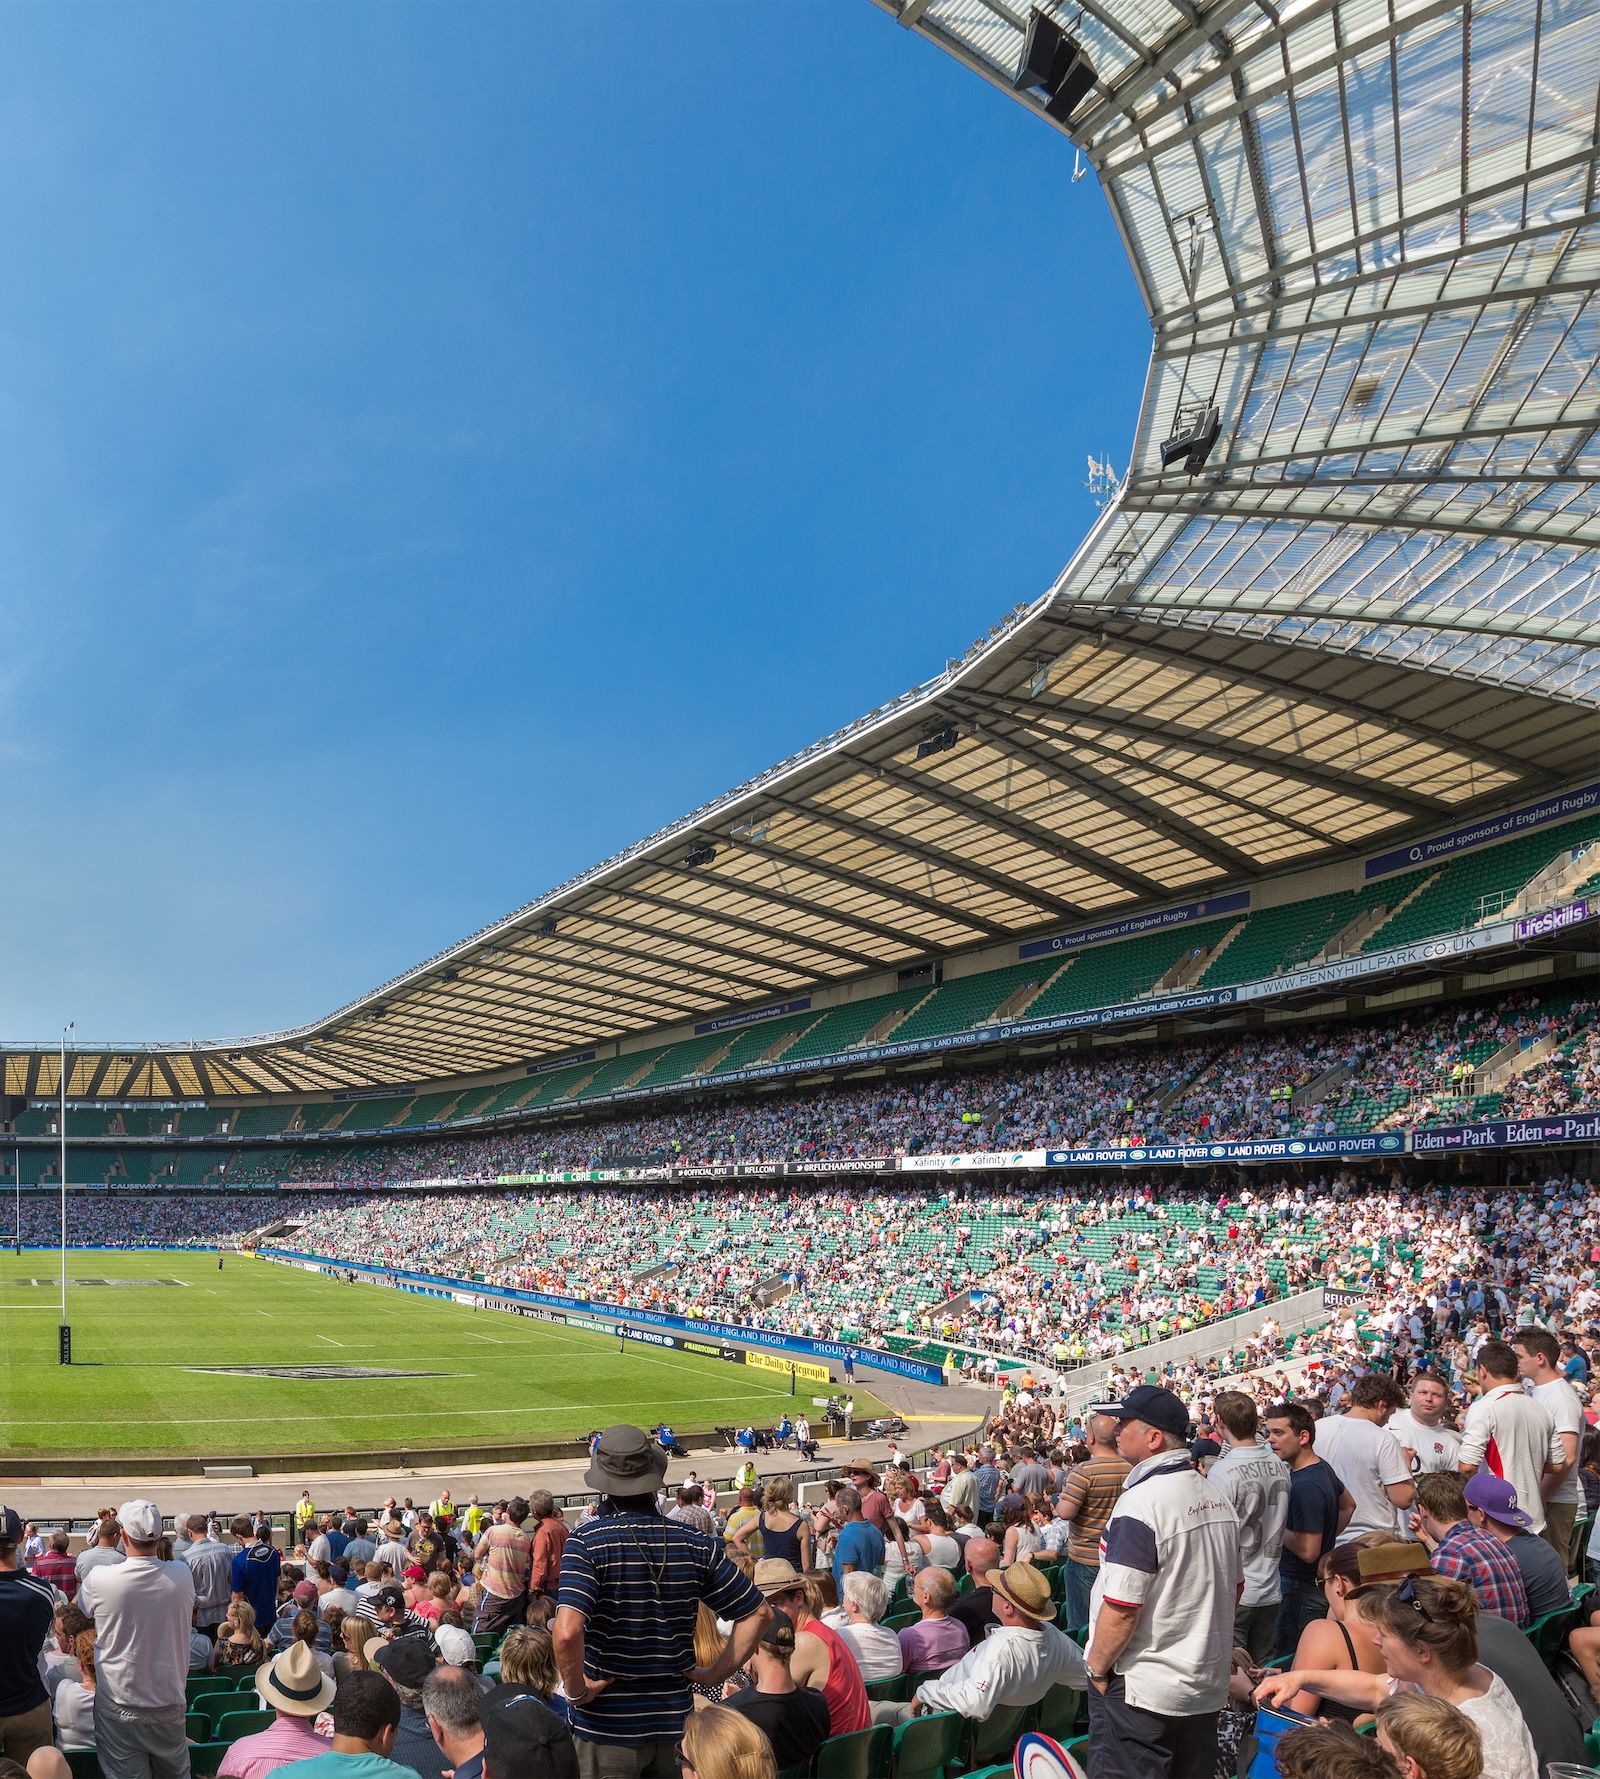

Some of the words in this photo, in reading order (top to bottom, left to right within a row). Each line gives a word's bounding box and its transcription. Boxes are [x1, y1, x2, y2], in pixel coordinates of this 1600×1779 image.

[1426, 839, 1455, 855] Proud
[1456, 824, 1500, 847] sponsors
[1502, 817, 1514, 830] of
[1516, 802, 1560, 827] England
[1561, 791, 1598, 812] Rugby
[1065, 934, 1086, 945] Proud
[1086, 927, 1119, 942] sponsors
[1120, 923, 1130, 932] of
[1130, 916, 1161, 931] England
[1163, 909, 1189, 922] Rugby
[1518, 905, 1583, 939] LifeSkills
[1264, 936, 1476, 994] WWW.PENNYHILLPARK.CO.UK
[1113, 995, 1215, 1019] RHINORUGBY.COM
[1011, 1014, 1098, 1034] RHINORUGBY.COM
[933, 1038, 951, 1048] LAND
[952, 1034, 975, 1045] ROVER
[881, 1047, 898, 1056] LAND
[898, 1044, 919, 1053] ROVER
[833, 1055, 848, 1064] LAND
[849, 1052, 868, 1062] ROVER
[747, 1070, 759, 1078] LAND
[759, 1067, 776, 1076] ROVER
[1413, 1133, 1445, 1151] Eden
[1462, 1127, 1496, 1148] Park
[1505, 1124, 1544, 1144] Eden
[1150, 1147, 1180, 1159] LAND
[1182, 1146, 1208, 1158] ROVER
[1228, 1145, 1251, 1156] LAND
[1253, 1143, 1286, 1155] ROVER
[1308, 1141, 1337, 1154] LAND
[1339, 1138, 1376, 1151] ROVER
[1070, 1150, 1094, 1161] LAND
[1096, 1149, 1127, 1161] ROVER
[745, 1166, 776, 1174] RFU.COM
[804, 1160, 886, 1172] @RFUCHAMPIONSHIP
[546, 1173, 565, 1182] CBRE
[571, 1172, 591, 1181] CBRE
[598, 1171, 620, 1181] CBRE
[537, 1294, 559, 1304] ENGLAND
[559, 1299, 575, 1307] RUGBY
[523, 1307, 566, 1325] www.killik.com
[589, 1303, 608, 1312] PROUD
[609, 1306, 616, 1314] OF
[616, 1308, 644, 1321] ENGLAND
[645, 1313, 666, 1324] RUGBY
[567, 1317, 584, 1327] GREENE
[584, 1321, 595, 1330] KING
[595, 1323, 605, 1332] IPA
[627, 1330, 643, 1340] LAND
[643, 1332, 663, 1344] ROVER
[685, 1320, 709, 1331] PROUD
[710, 1324, 720, 1333] OF
[721, 1326, 758, 1341] ENGLAND
[759, 1332, 787, 1346] RUGBY
[748, 1352, 763, 1363] The
[764, 1355, 784, 1371] Daily
[813, 1342, 845, 1355] PROUD
[860, 1350, 898, 1369] ENGLAND
[900, 1360, 928, 1377] RUGBY
[1508, 1495, 1517, 1510] NY
